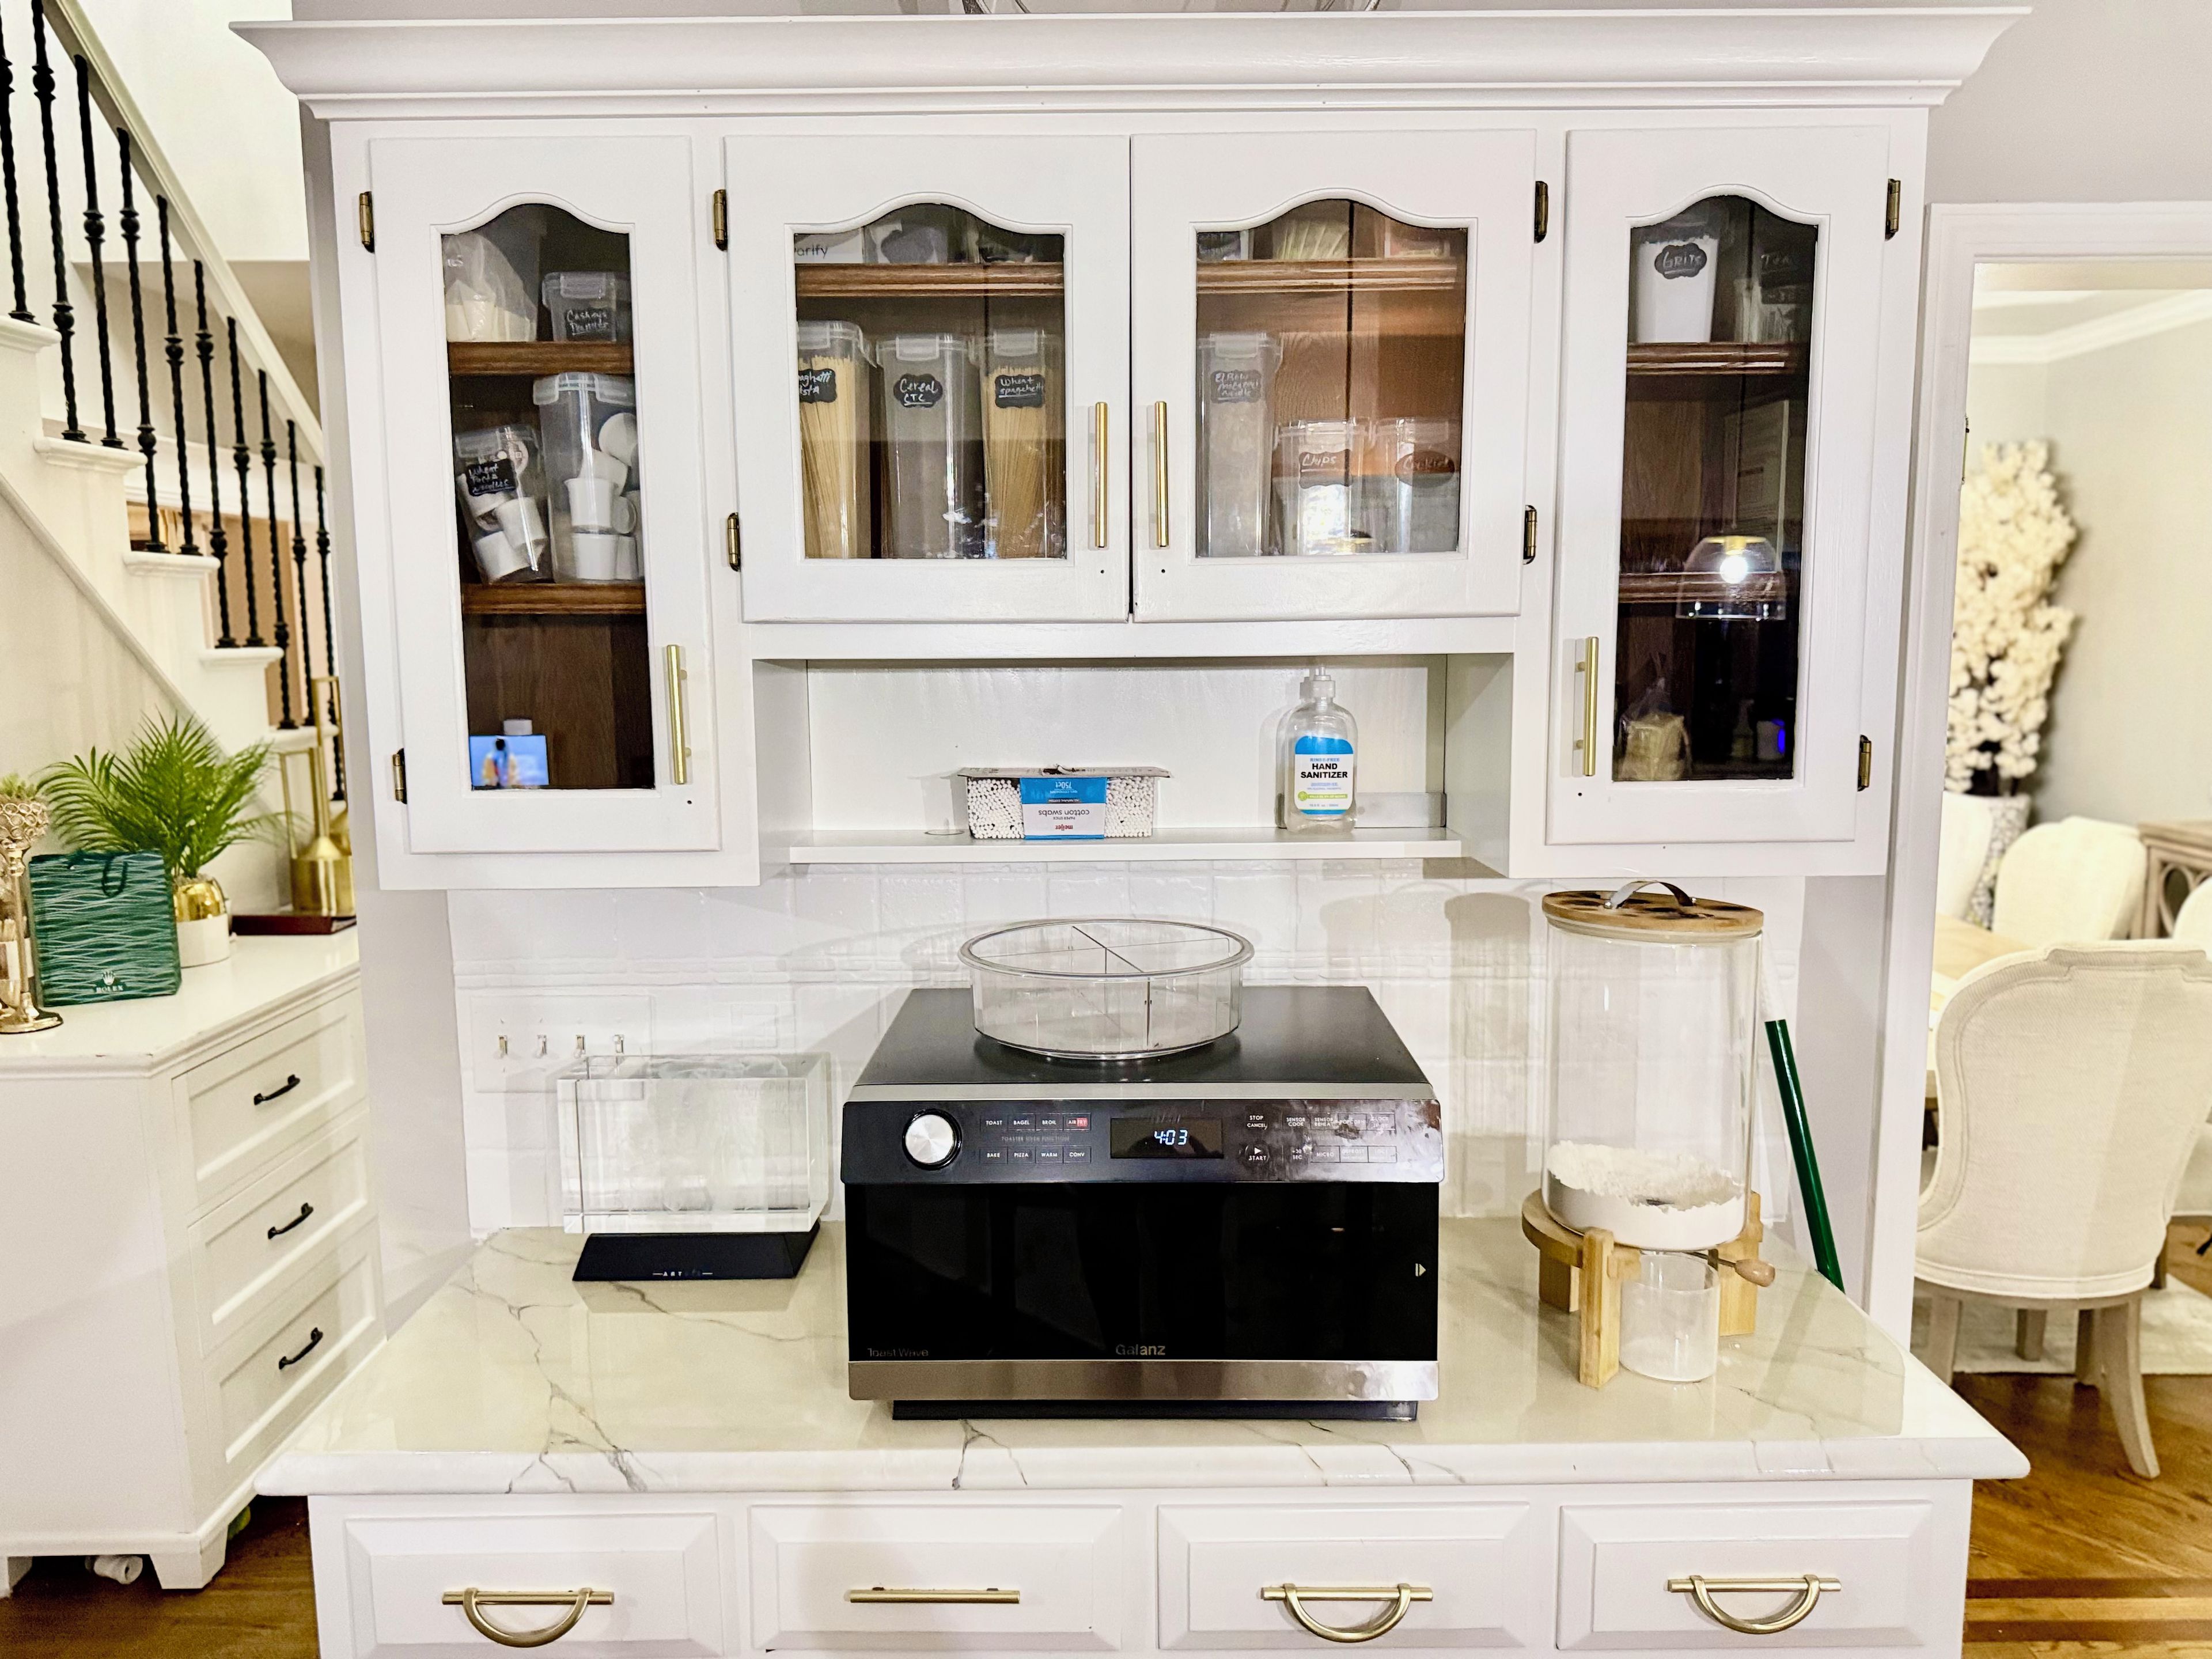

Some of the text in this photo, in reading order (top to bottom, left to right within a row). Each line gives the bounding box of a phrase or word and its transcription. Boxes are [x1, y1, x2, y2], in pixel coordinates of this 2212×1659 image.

[795, 244, 828, 259] arify
[900, 378, 939, 393] Cereal
[1001, 377, 1035, 387] Wheat
[96, 985, 123, 994] ROLEX
[1154, 1130, 1188, 1145] 4:03
[1115, 1344, 1166, 1355] Galanz
